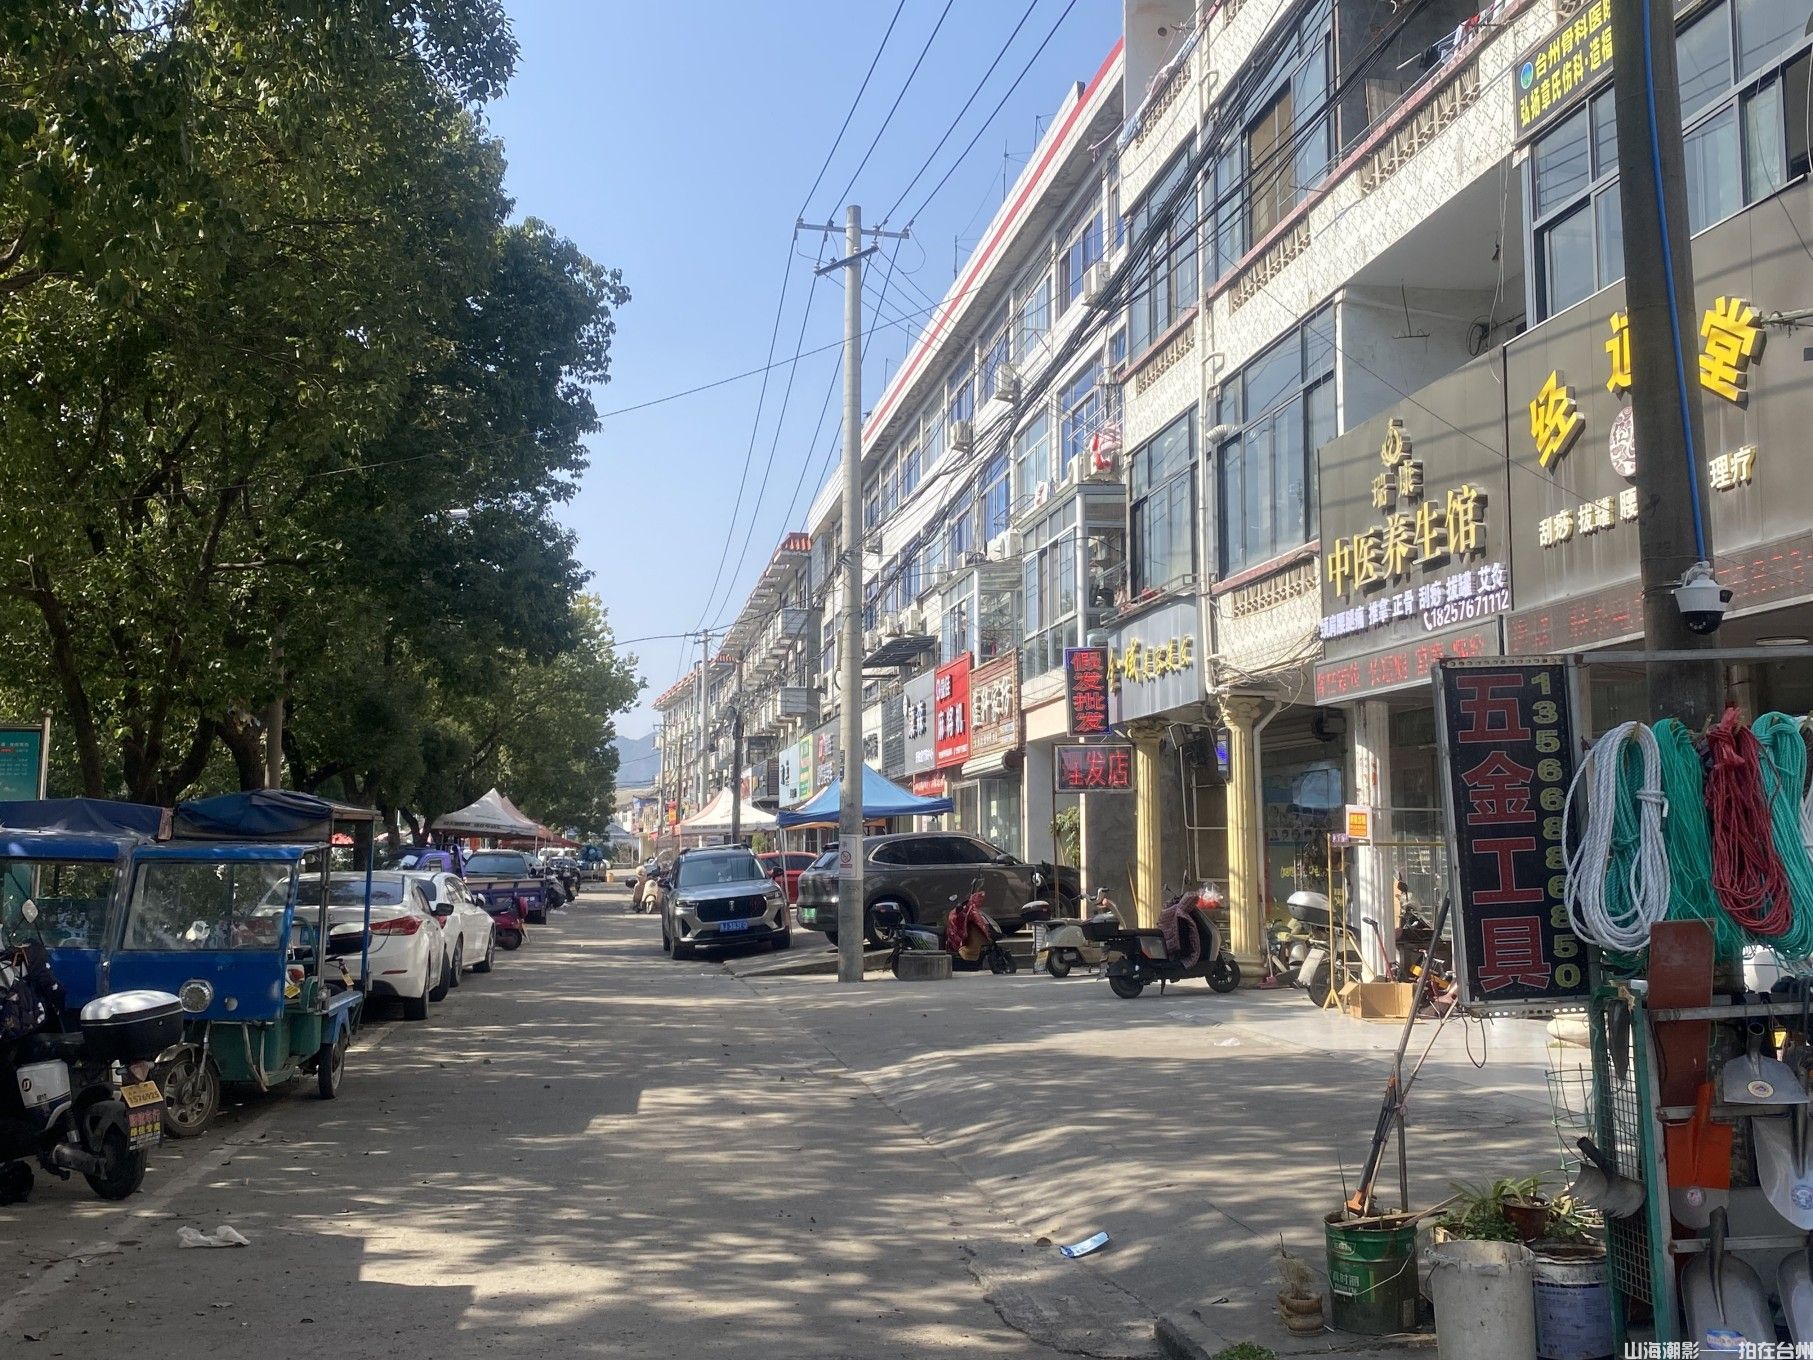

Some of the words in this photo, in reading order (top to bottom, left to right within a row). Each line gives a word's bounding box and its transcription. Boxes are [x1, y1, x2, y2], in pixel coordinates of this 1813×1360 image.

[1539, 510, 1572, 547] 刮痧
[1578, 496, 1615, 535] 拔罐
[1709, 446, 1756, 490] 理疗
[1328, 484, 1478, 599] 中医养生馆
[1393, 589, 1414, 617] 正骨
[1418, 580, 1443, 611] 刮痧
[1477, 562, 1506, 595] 艾灸
[1431, 589, 1510, 629] 18257671112
[1072, 651, 1106, 733] 假发批发
[1061, 750, 1129, 786] 理发店
[1456, 673, 1552, 993] 五金工具
